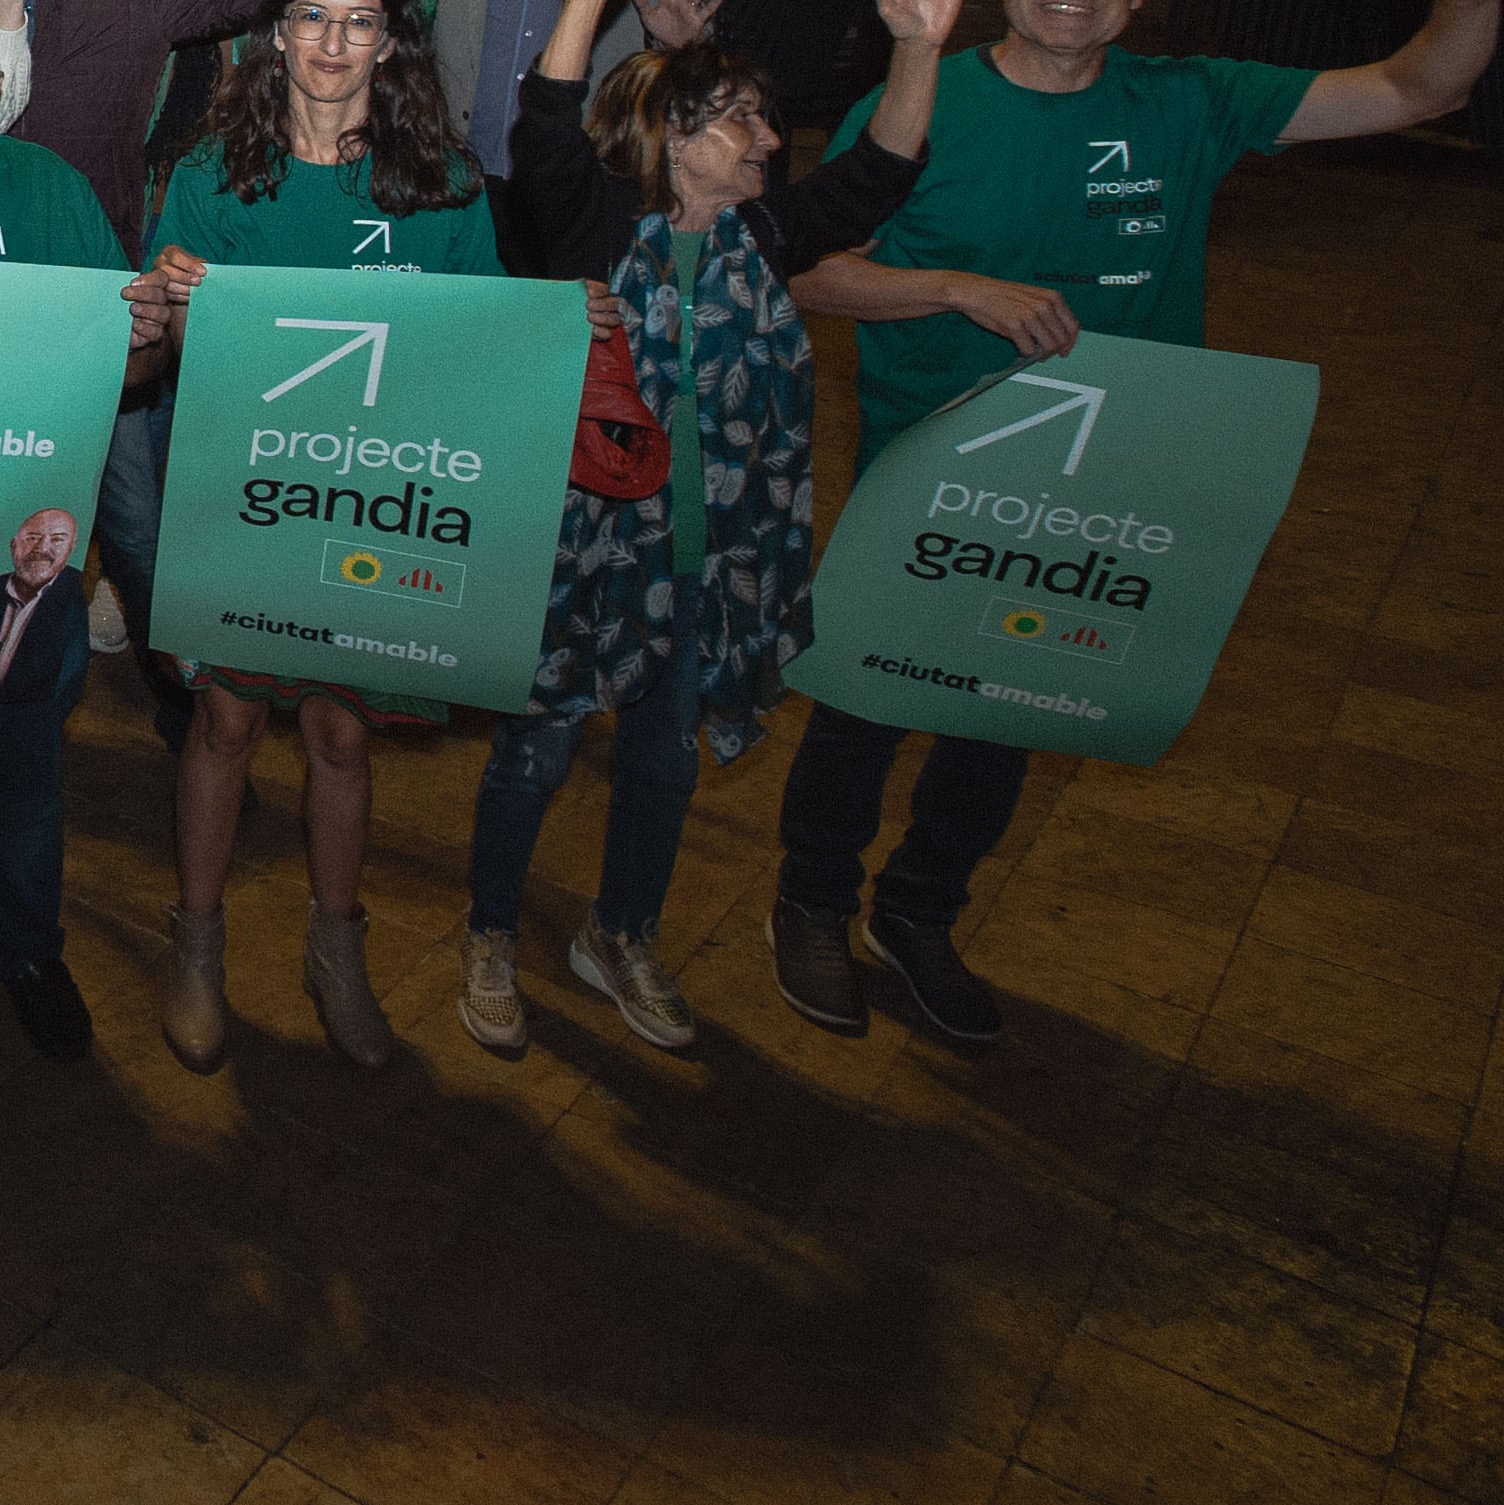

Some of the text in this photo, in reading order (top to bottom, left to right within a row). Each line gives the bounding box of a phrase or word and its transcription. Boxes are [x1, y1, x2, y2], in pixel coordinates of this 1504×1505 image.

[249, 425, 483, 483] projecte
[238, 477, 473, 547] gandia
[927, 478, 1175, 555] projecte
[903, 530, 1153, 611] gandia
[219, 610, 459, 669] #ciutatamable
[860, 652, 1109, 722] #ciutatamable
